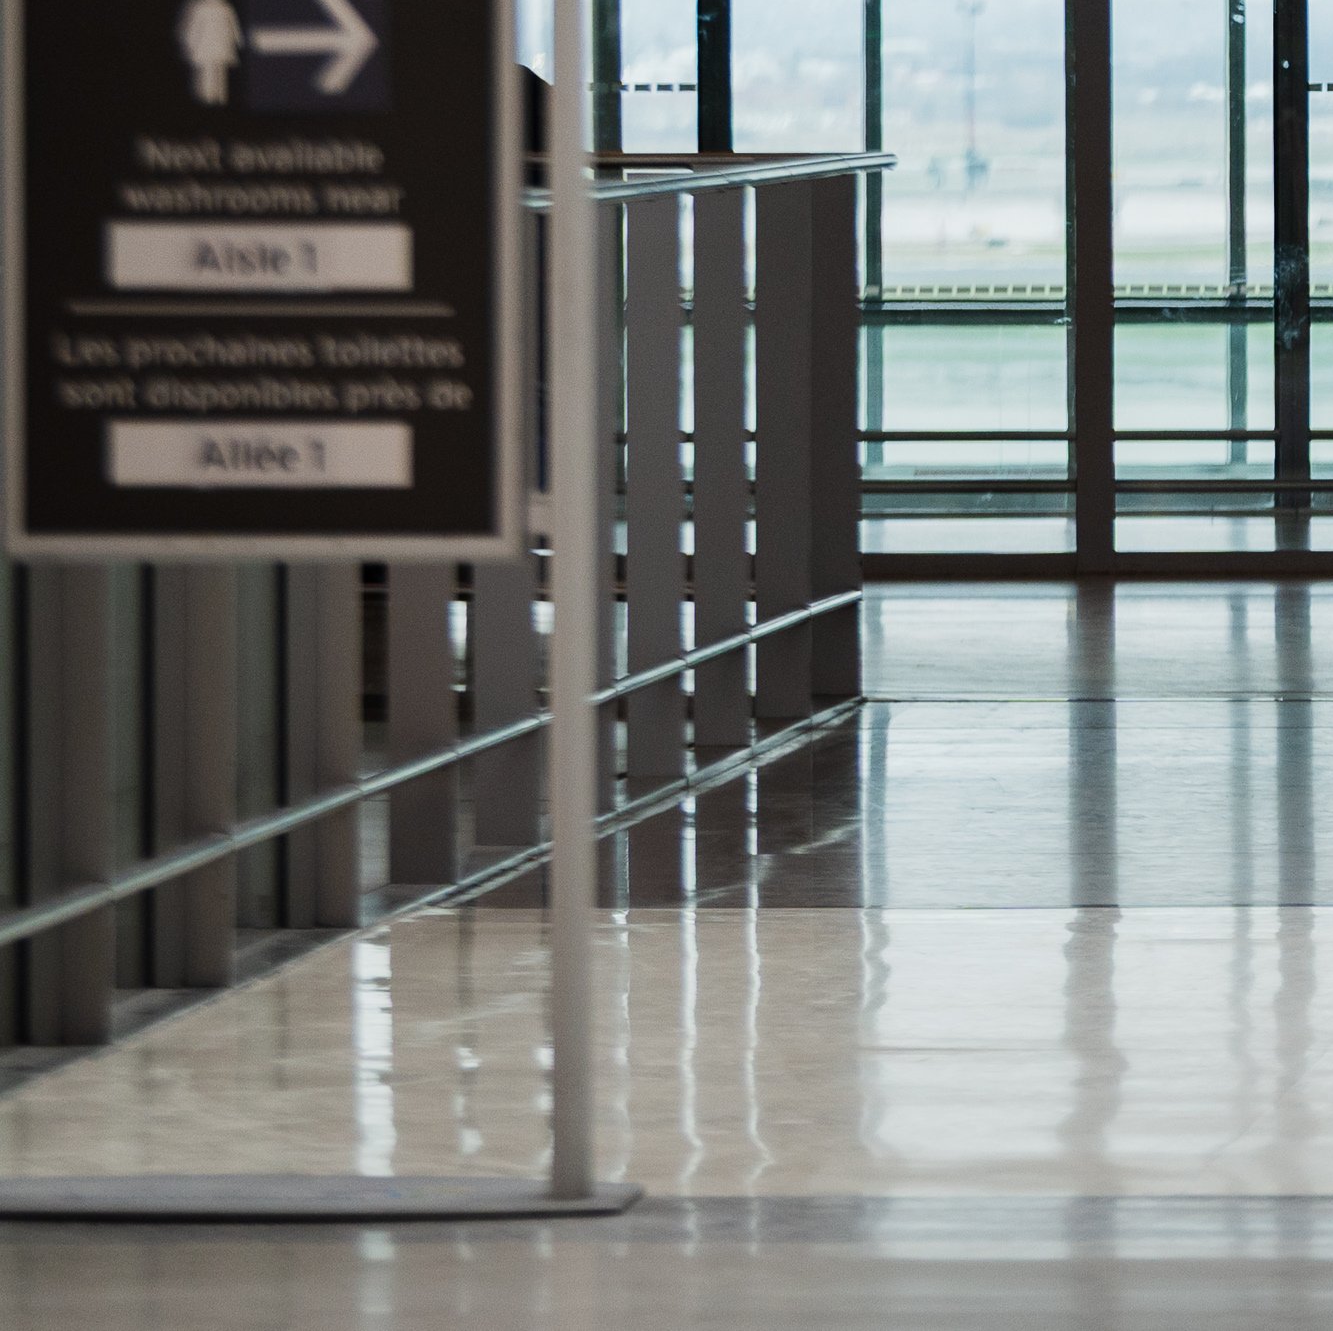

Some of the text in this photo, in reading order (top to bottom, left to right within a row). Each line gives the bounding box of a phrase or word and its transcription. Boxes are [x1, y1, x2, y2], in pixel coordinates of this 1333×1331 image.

[135, 137, 386, 172] Next available
[120, 182, 404, 213] washrooms near
[192, 239, 319, 275] Aisle 1
[55, 333, 465, 372] Les prochaines toilettes
[59, 376, 135, 409] sont
[142, 376, 338, 413] disponibles
[426, 378, 473, 411] de
[305, 440, 327, 473] 1
